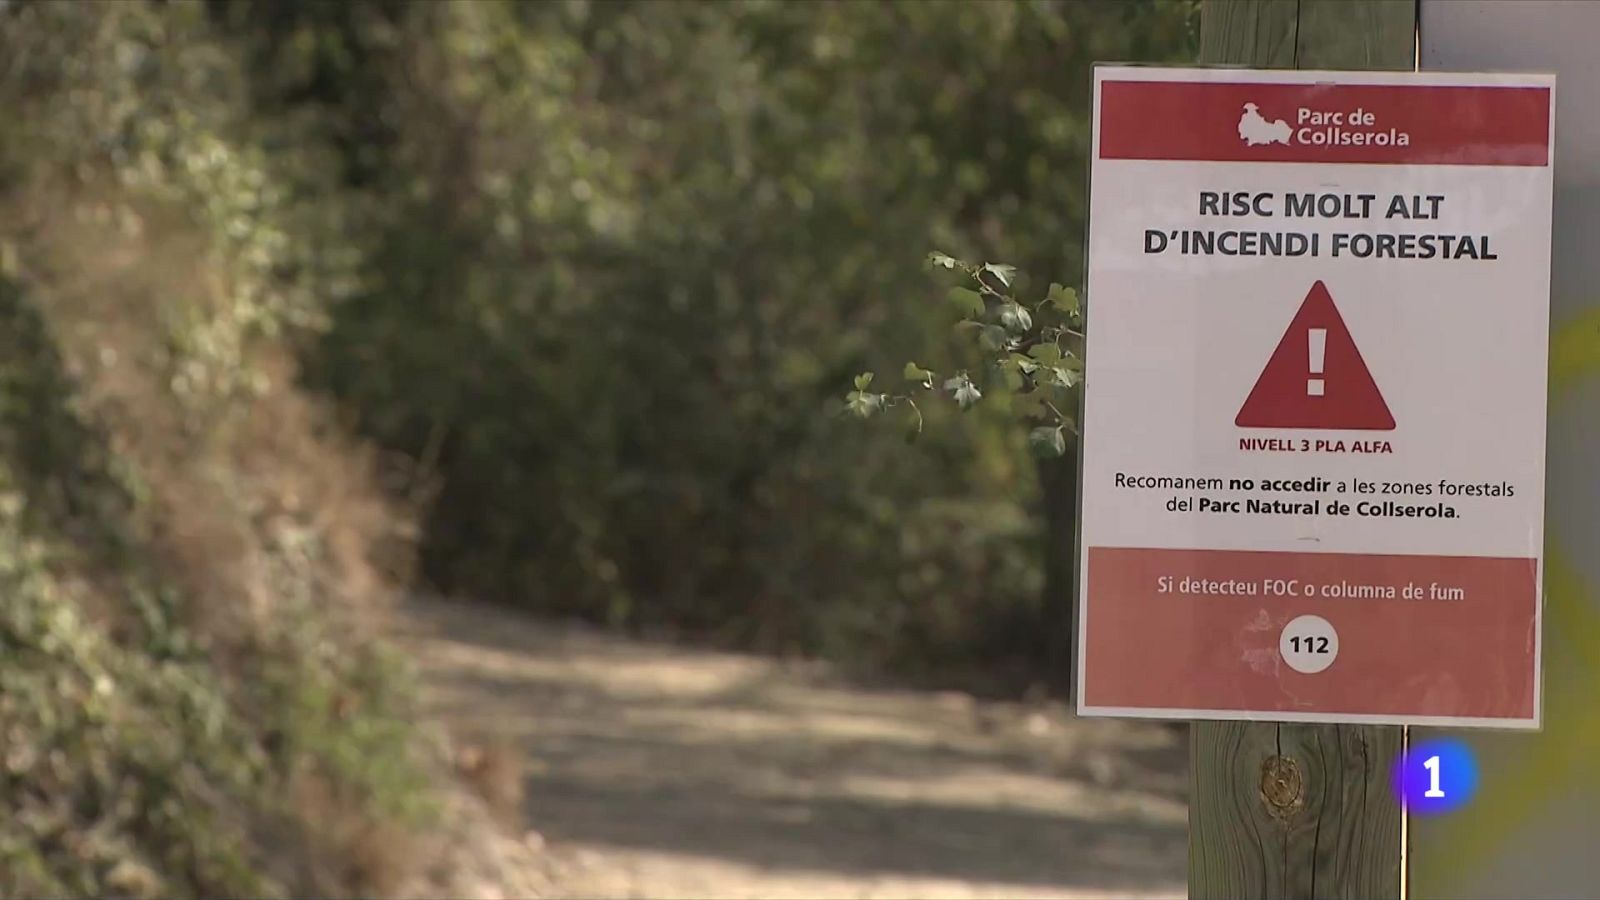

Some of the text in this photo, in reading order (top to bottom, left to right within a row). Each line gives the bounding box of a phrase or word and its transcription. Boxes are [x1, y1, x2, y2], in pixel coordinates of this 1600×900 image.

[1298, 108, 1375, 126] Parc de
[1298, 126, 1410, 146] Collserola
[1200, 192, 1444, 219] RISC MOLT ALT
[1145, 230, 1497, 260] D’INCENDI FORESTAL
[1240, 439, 1392, 453] NIVELL 3 PLA ALFA
[1116, 473, 1514, 496] Recomanem no accedir a les zones forestals
[1167, 497, 1459, 518] del Parc Natural de Collserola.
[1158, 576, 1463, 600] Si detecteu FOC o columna de fum
[1290, 637, 1328, 653] 112
